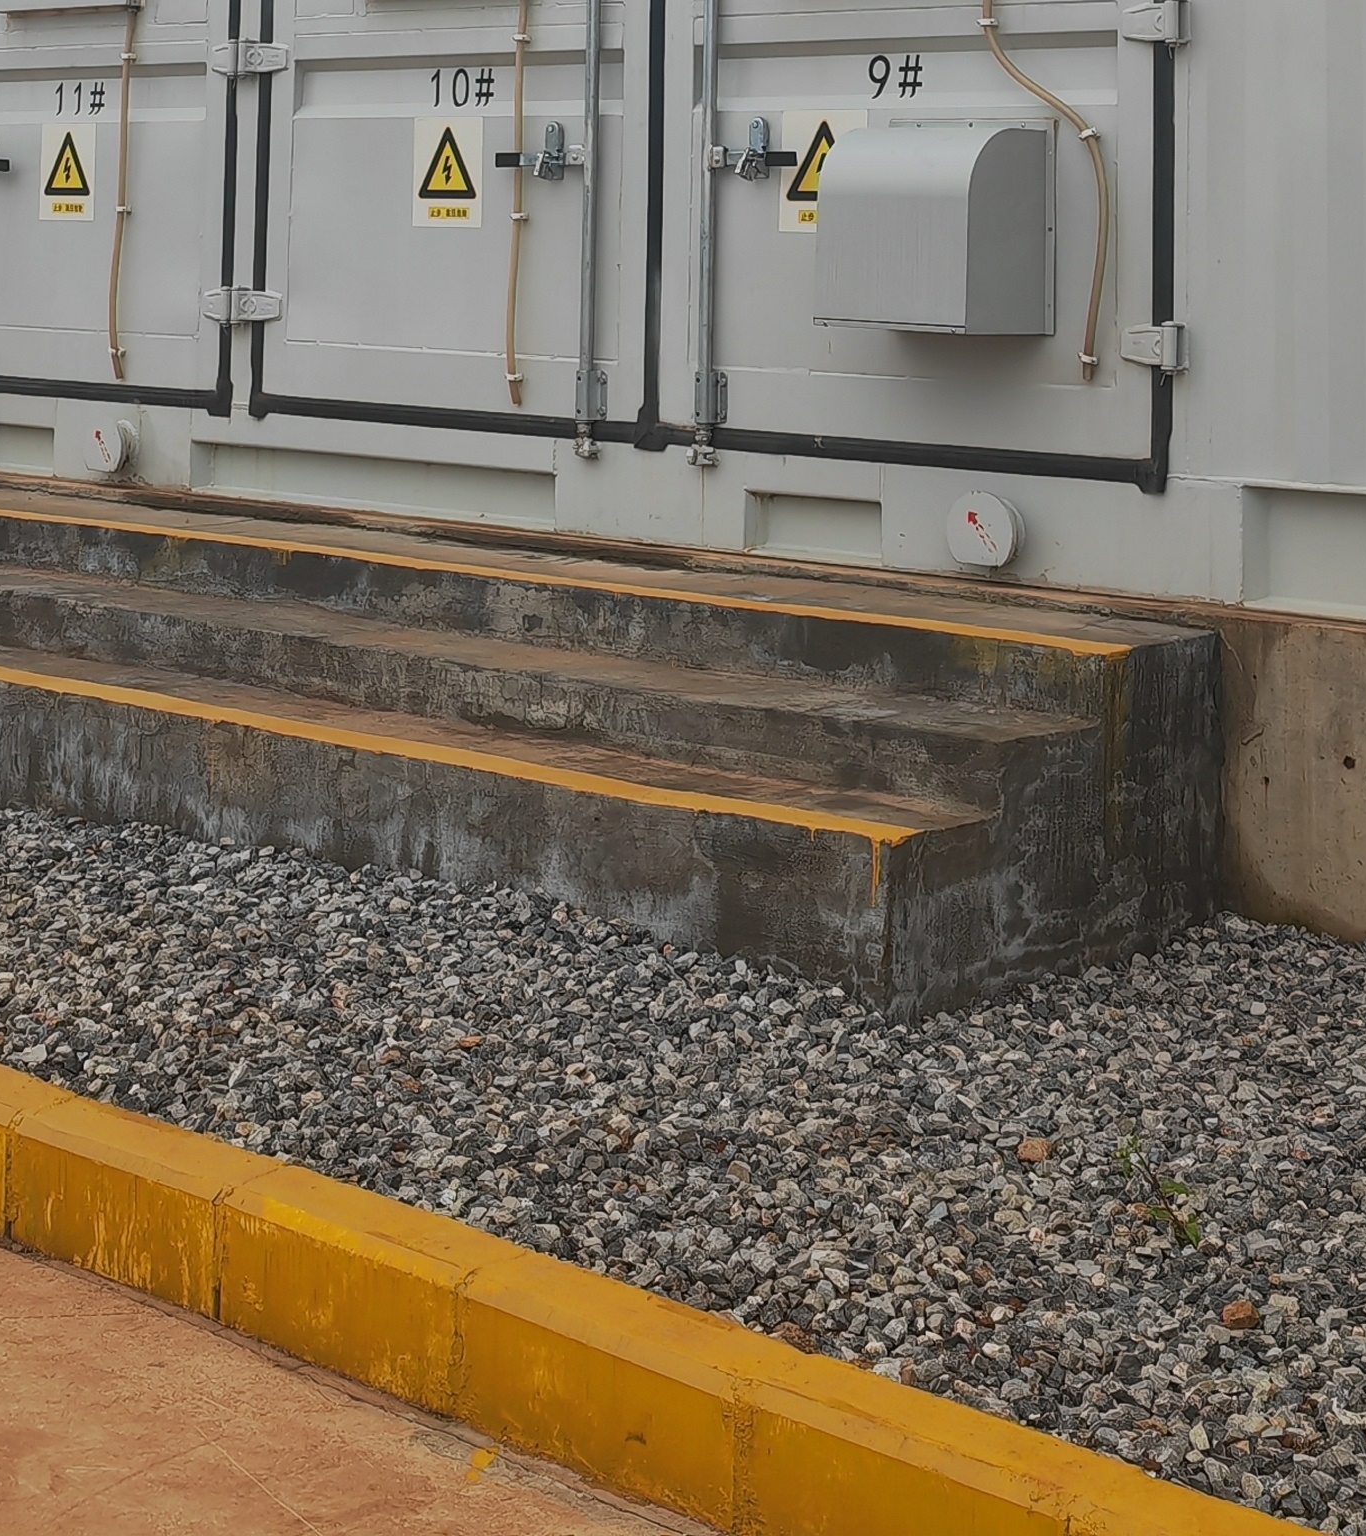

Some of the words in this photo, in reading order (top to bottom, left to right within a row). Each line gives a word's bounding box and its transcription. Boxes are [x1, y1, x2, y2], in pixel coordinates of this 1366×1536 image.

[431, 68, 495, 107] 10#
[868, 54, 923, 99] 9#
[55, 81, 105, 116] 11#
